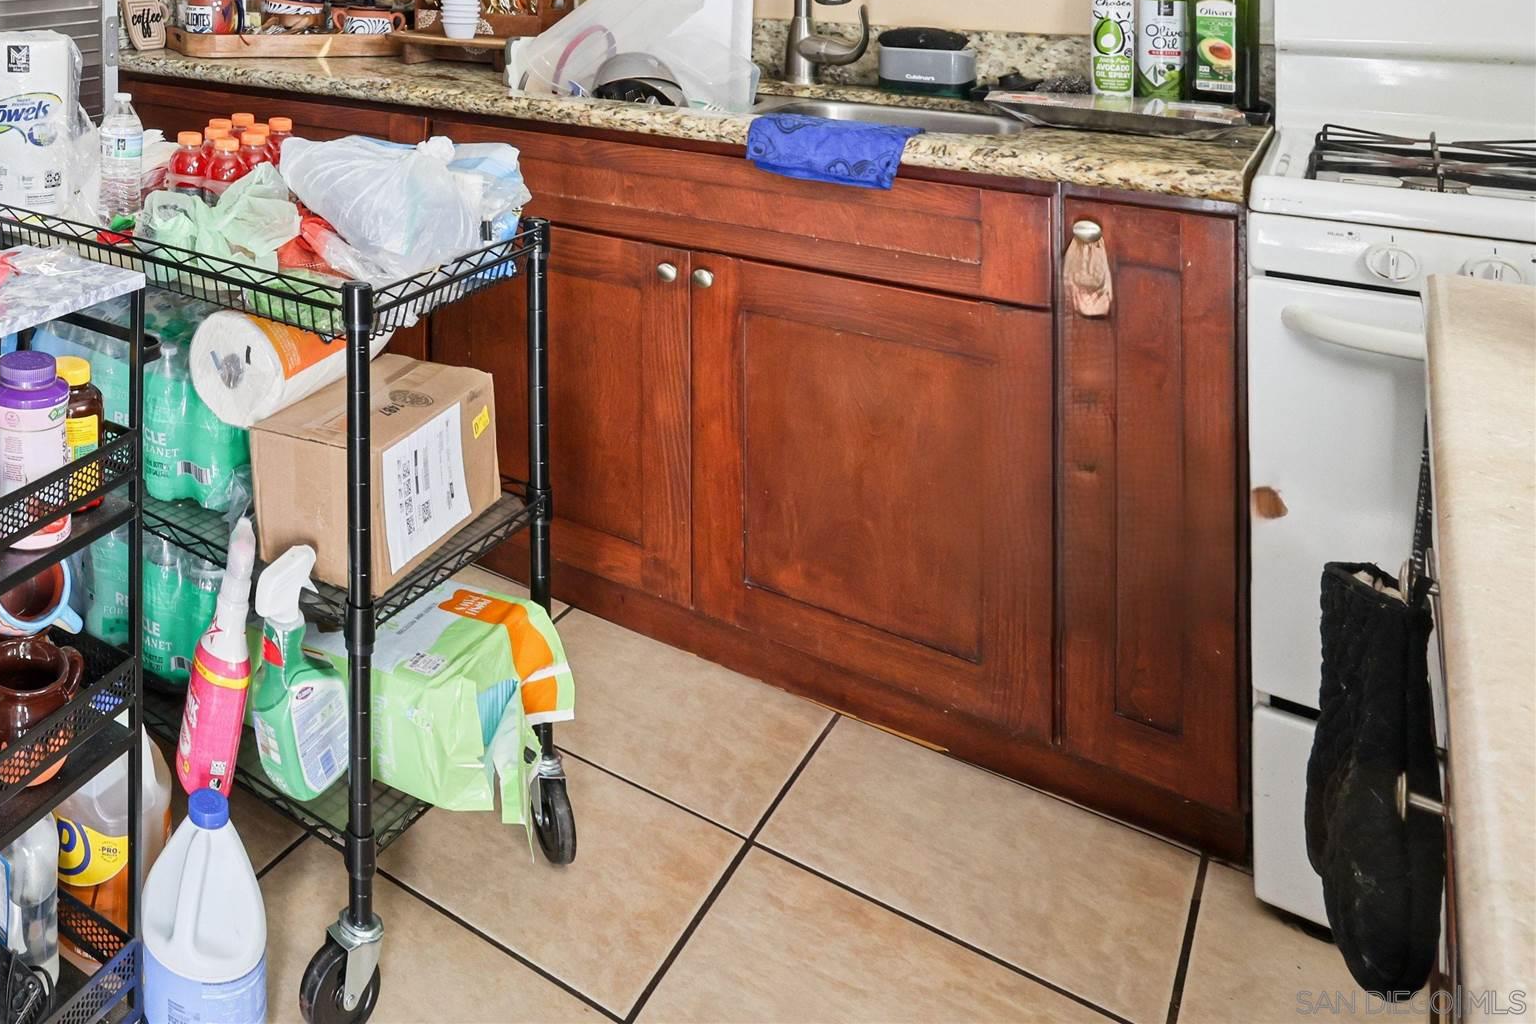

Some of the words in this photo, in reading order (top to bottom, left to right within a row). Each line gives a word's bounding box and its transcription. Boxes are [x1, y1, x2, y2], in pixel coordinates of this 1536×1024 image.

[131, 8, 162, 38] coffee
[1145, 23, 1183, 37] Olive
[1152, 36, 1178, 49] Oil
